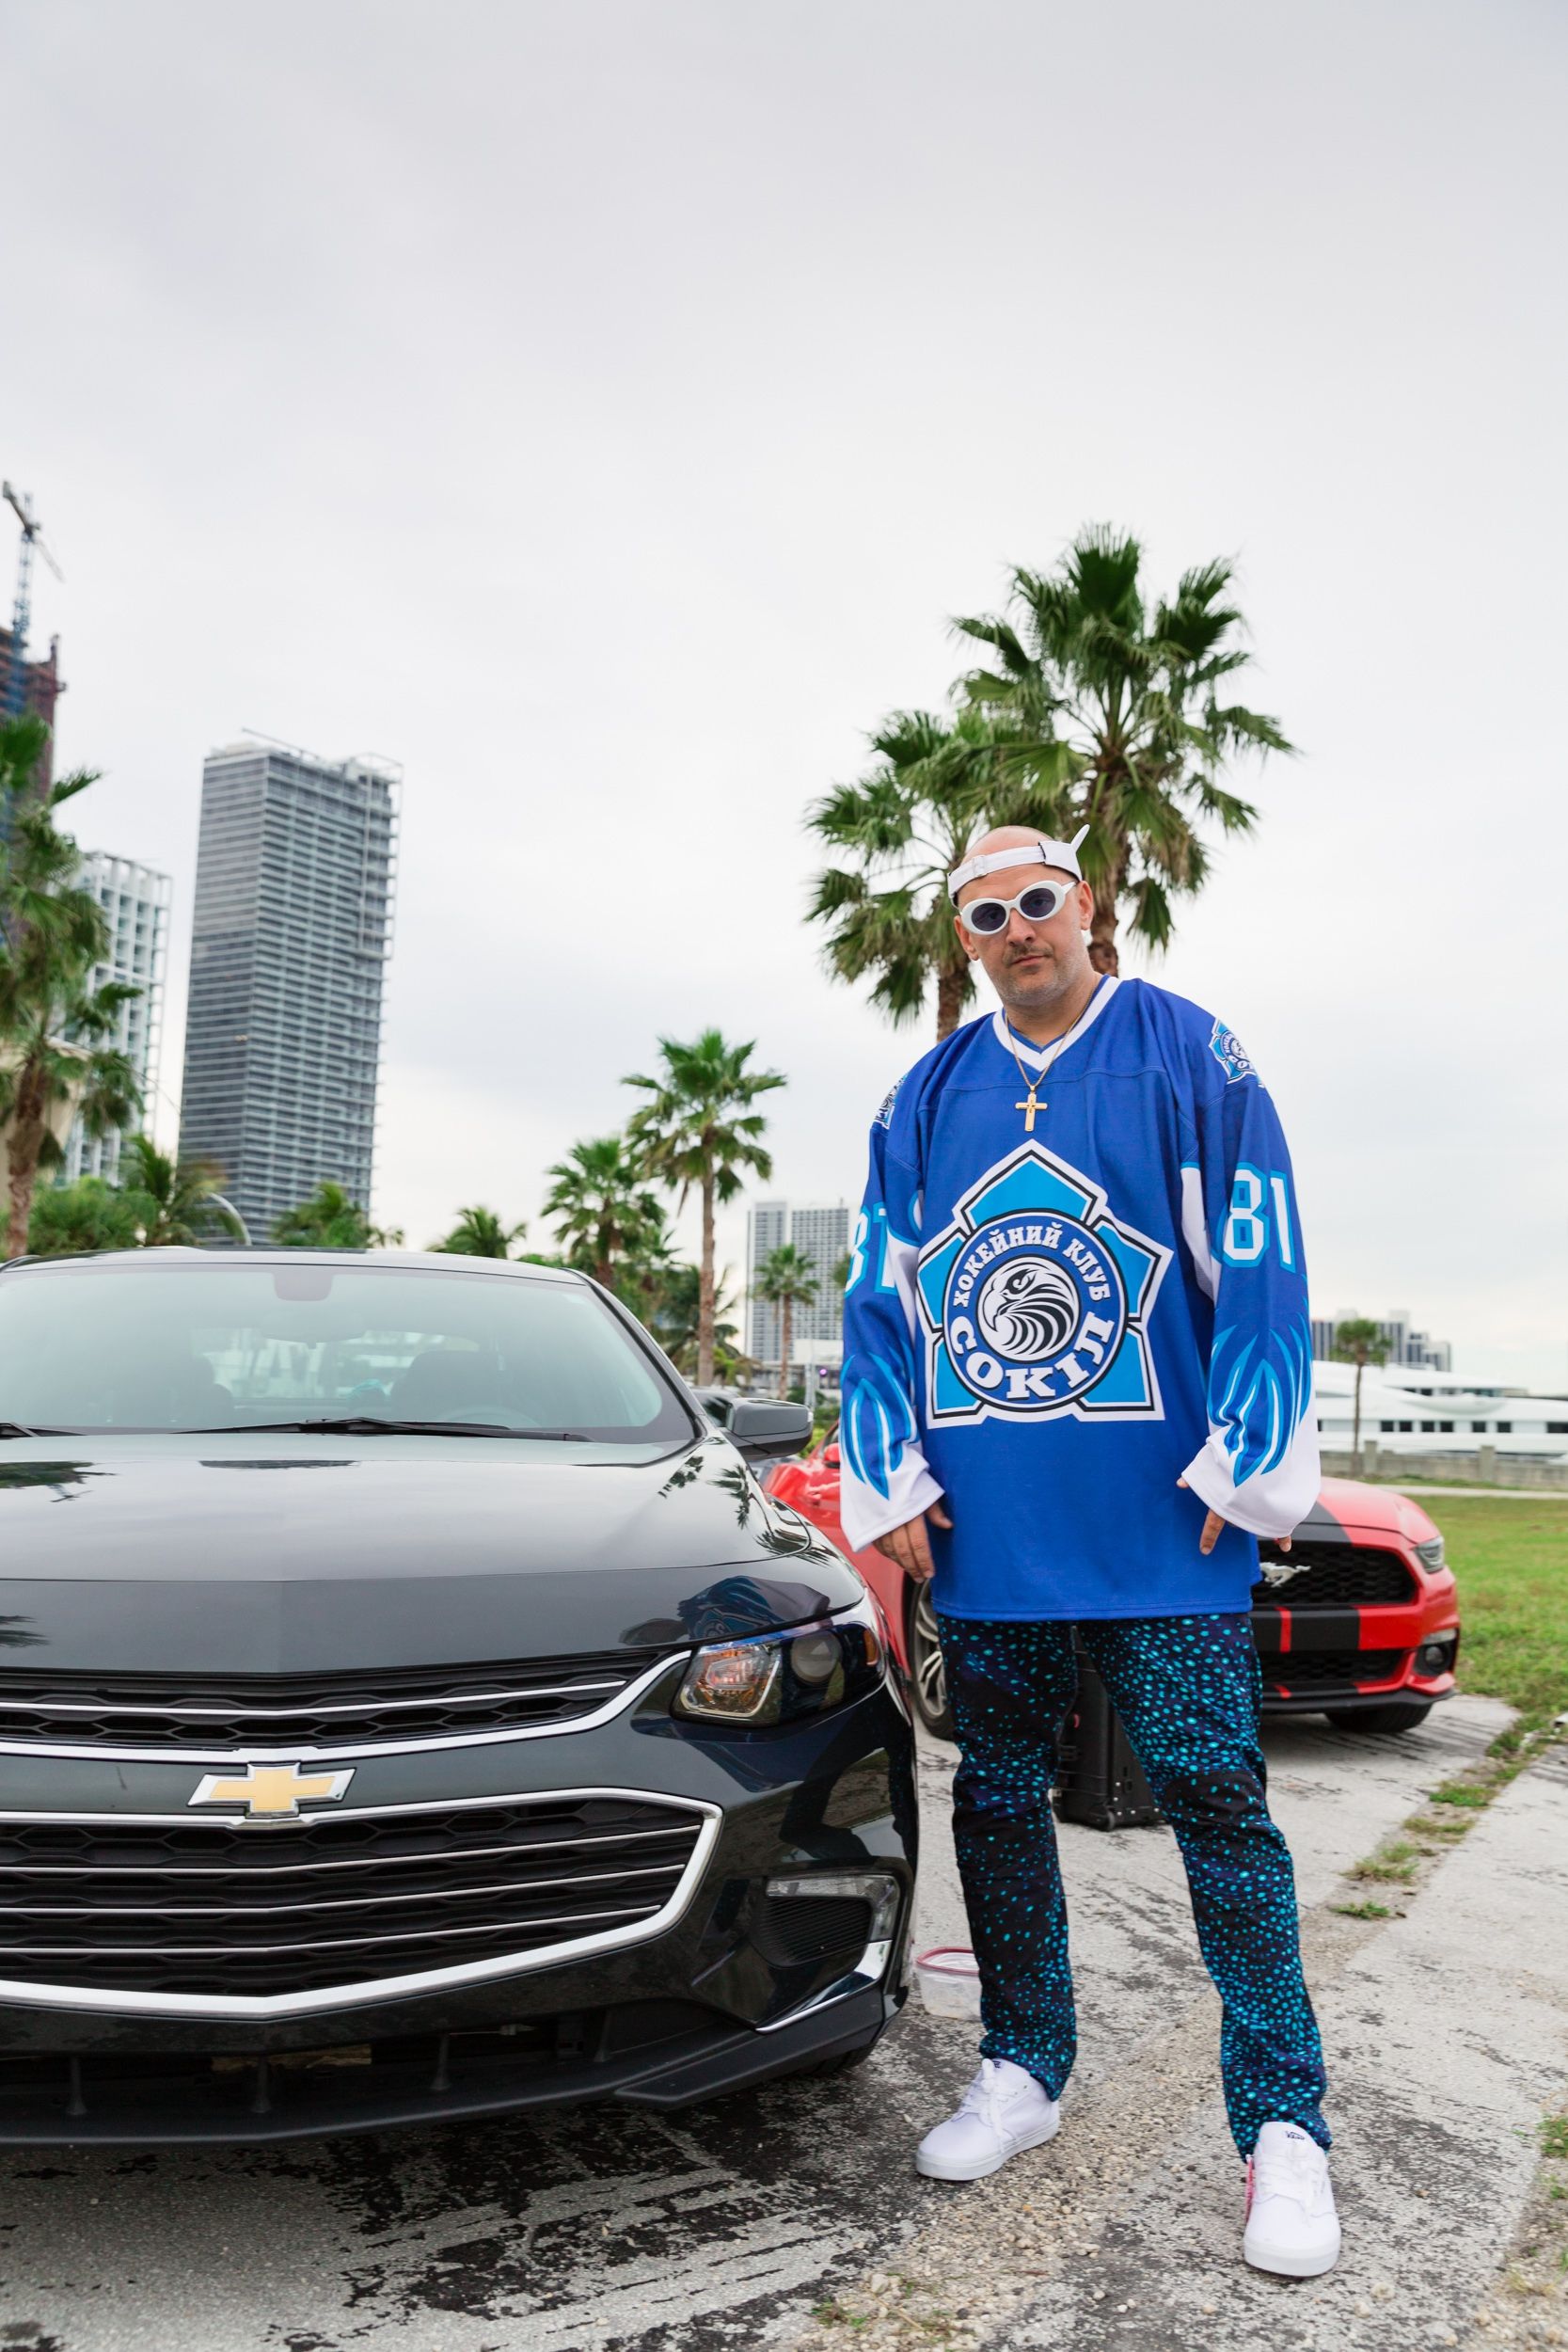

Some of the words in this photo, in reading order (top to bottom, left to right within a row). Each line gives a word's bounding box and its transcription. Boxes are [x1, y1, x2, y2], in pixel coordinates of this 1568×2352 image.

[1218, 1162, 1295, 1273] 81
[953, 1222, 1063, 1308] ХОКЕЙНИЙ
[1063, 1238, 1111, 1302] КЛУБ
[950, 1311, 1115, 1400] СОКІЛ
